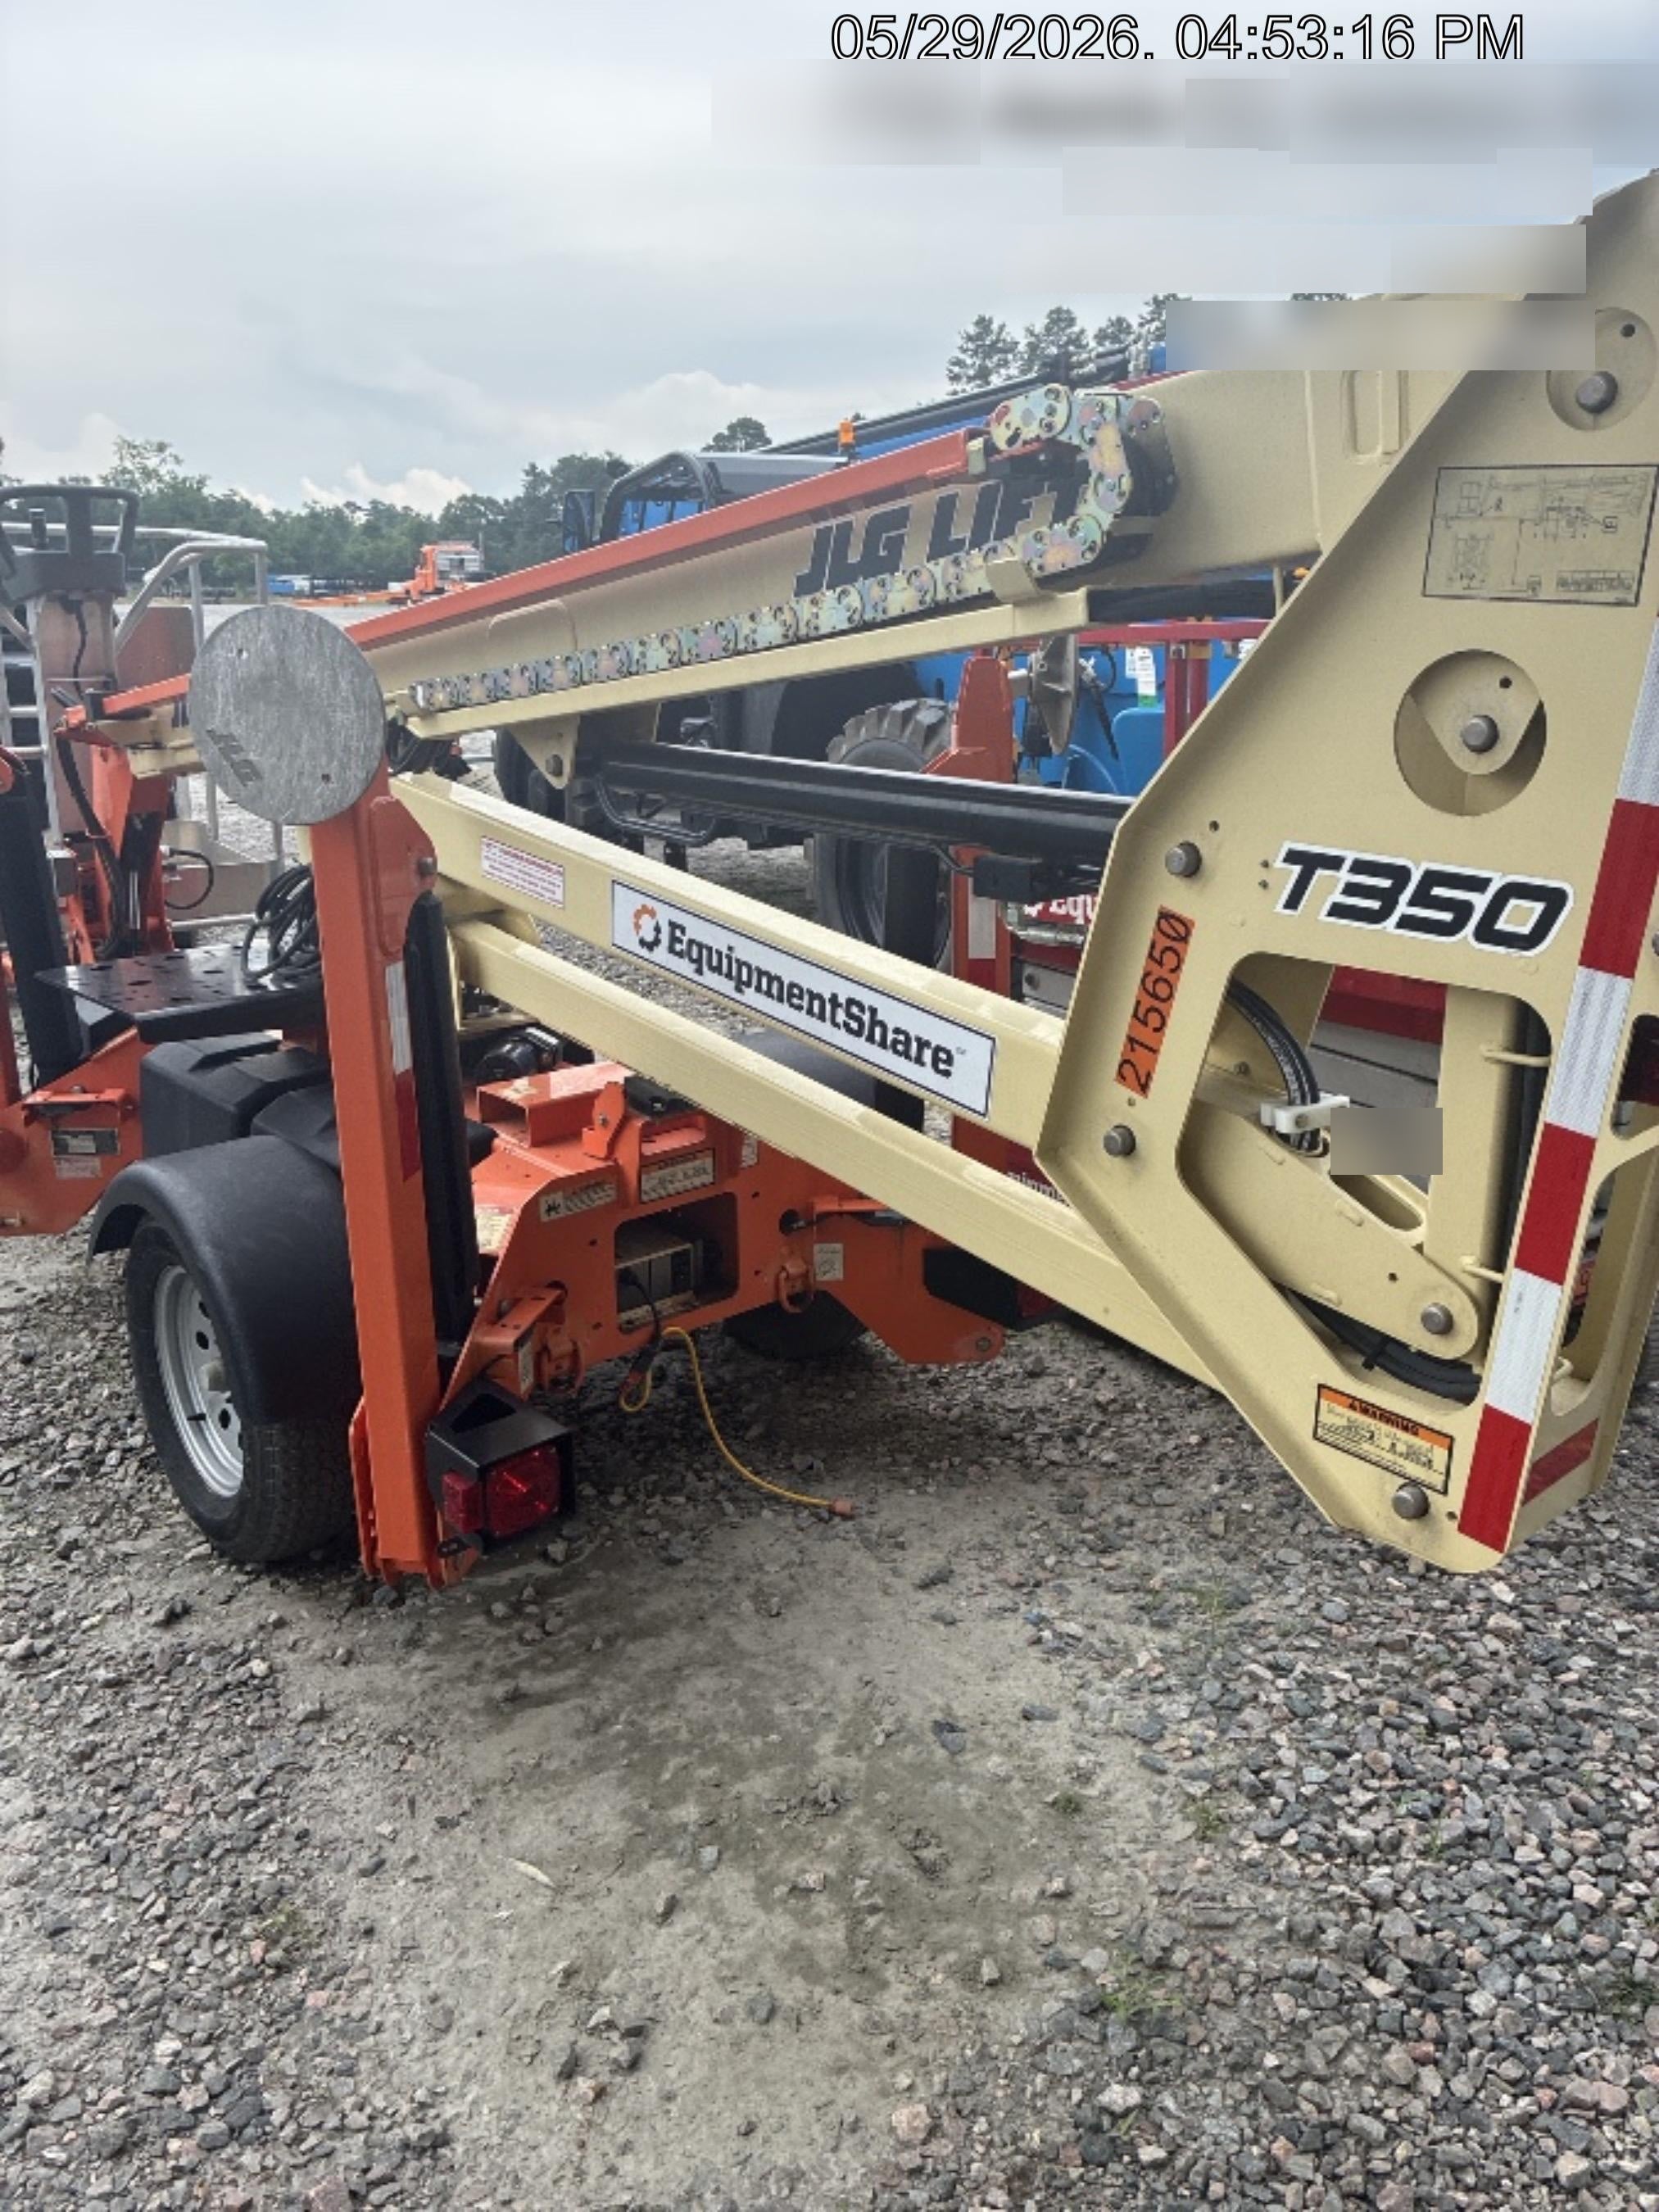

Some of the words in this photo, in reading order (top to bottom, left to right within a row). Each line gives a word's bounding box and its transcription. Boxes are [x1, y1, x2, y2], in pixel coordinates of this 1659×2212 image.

[793, 504, 911, 598] JLG
[1275, 841, 1574, 957] T350
[667, 918, 954, 1079] EquipmentShare
[1117, 913, 1192, 1095] 215650
